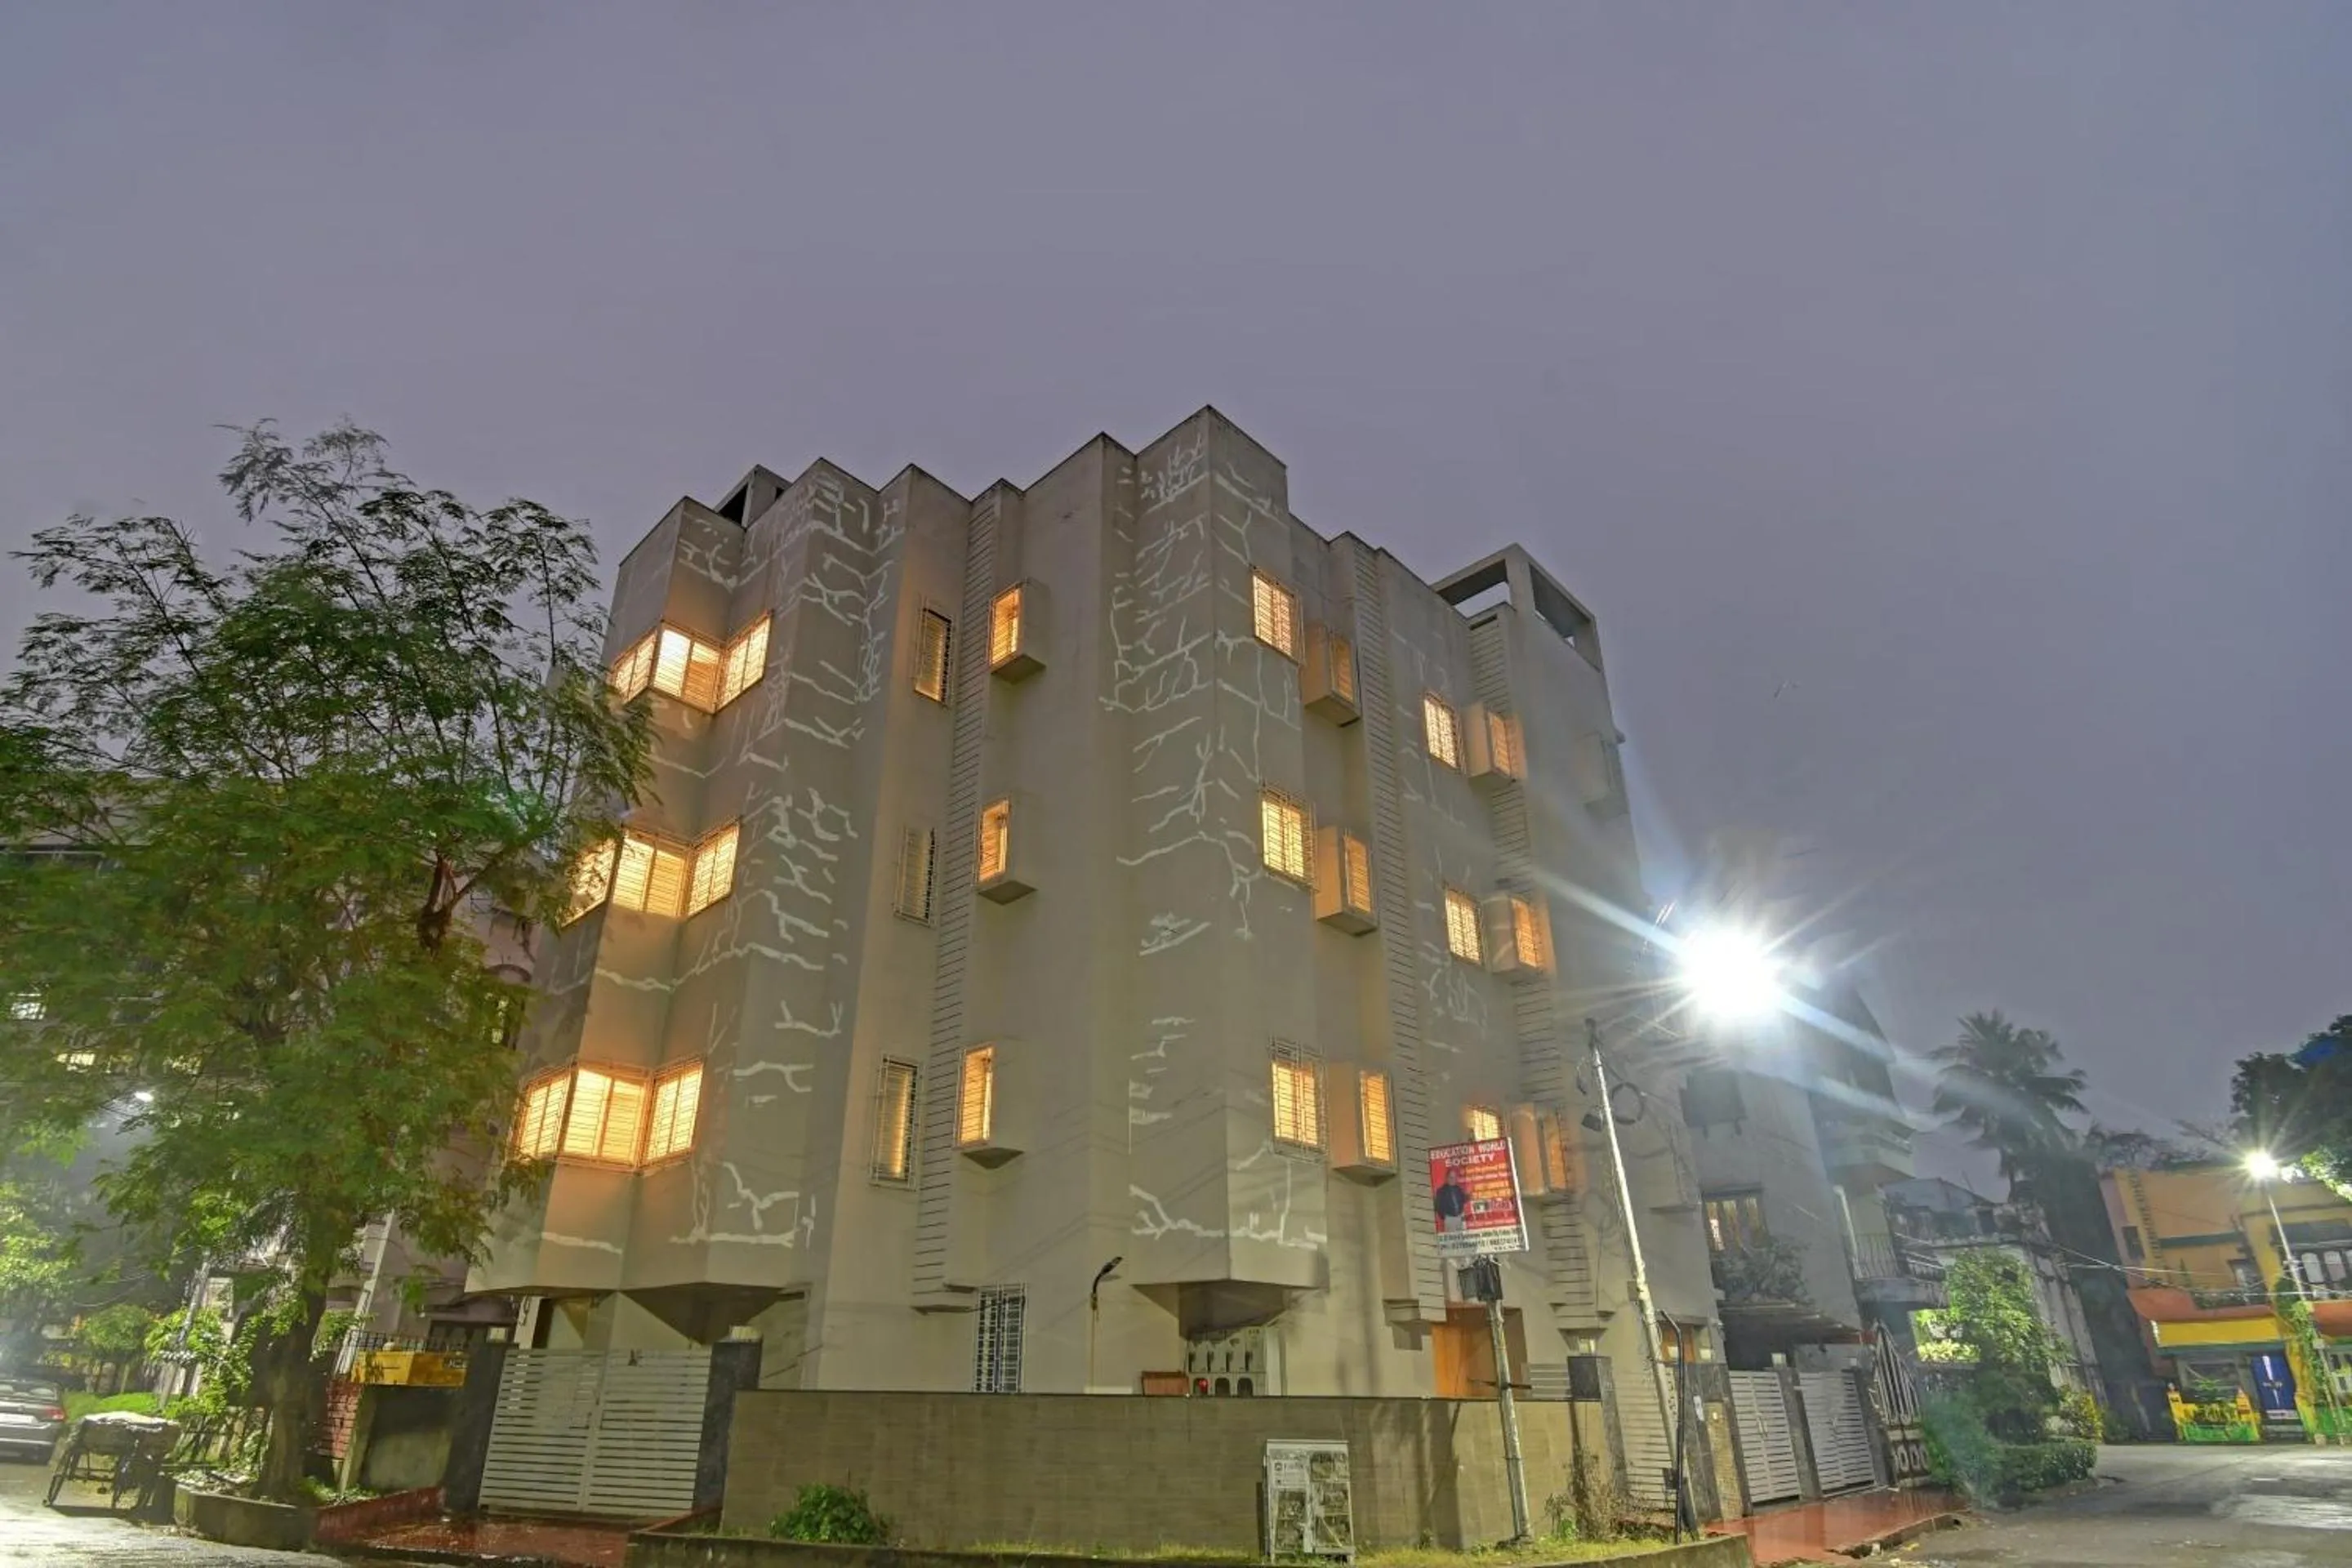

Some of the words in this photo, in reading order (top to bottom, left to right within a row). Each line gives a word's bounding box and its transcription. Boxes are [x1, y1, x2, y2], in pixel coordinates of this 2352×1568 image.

[1430, 1144, 1474, 1159] EDUCATION
[1478, 1139, 1505, 1153] WORLD
[1445, 1153, 1494, 1167] SOCIETY
